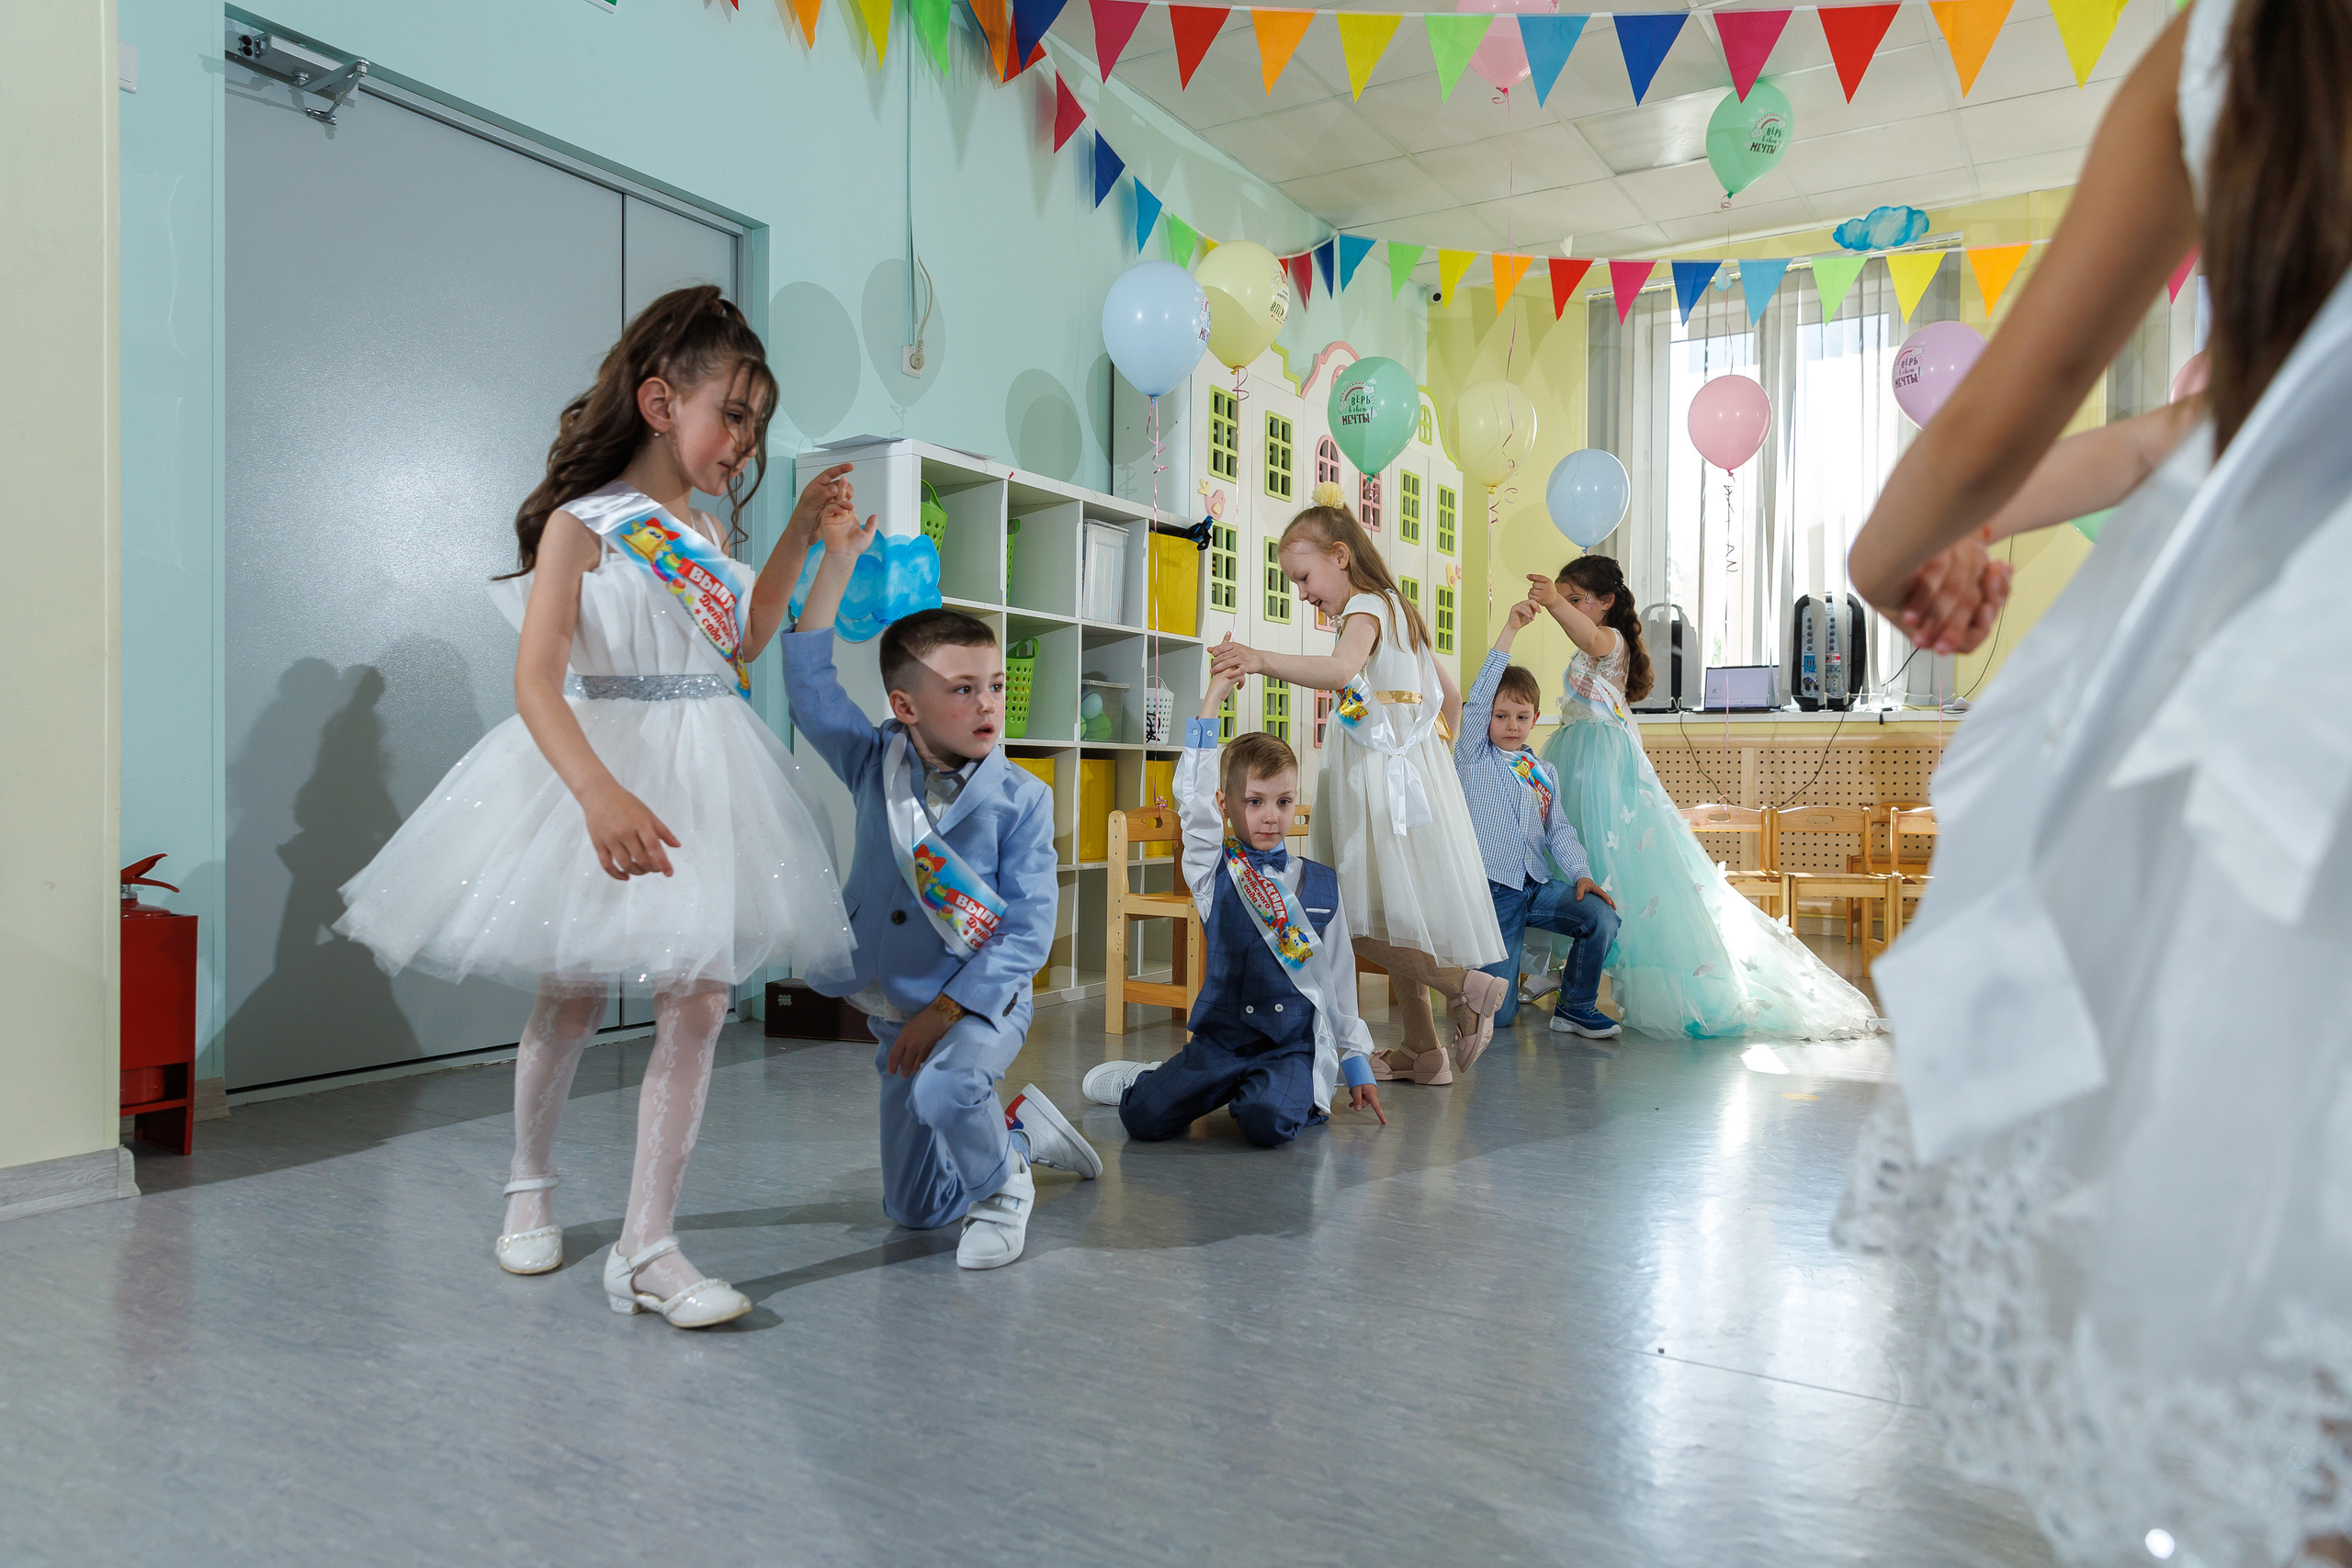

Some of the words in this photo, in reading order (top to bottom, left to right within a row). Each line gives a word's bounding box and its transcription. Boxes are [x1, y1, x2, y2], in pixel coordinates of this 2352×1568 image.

[1766, 127, 1782, 138] ВЕРЬ
[1901, 356, 1918, 368] ВЕРЬ
[1351, 394, 1371, 406] ВЕРЬ
[701, 617, 722, 642] сада
[1242, 868, 1271, 909] Детского
[1243, 884, 1258, 904] сада
